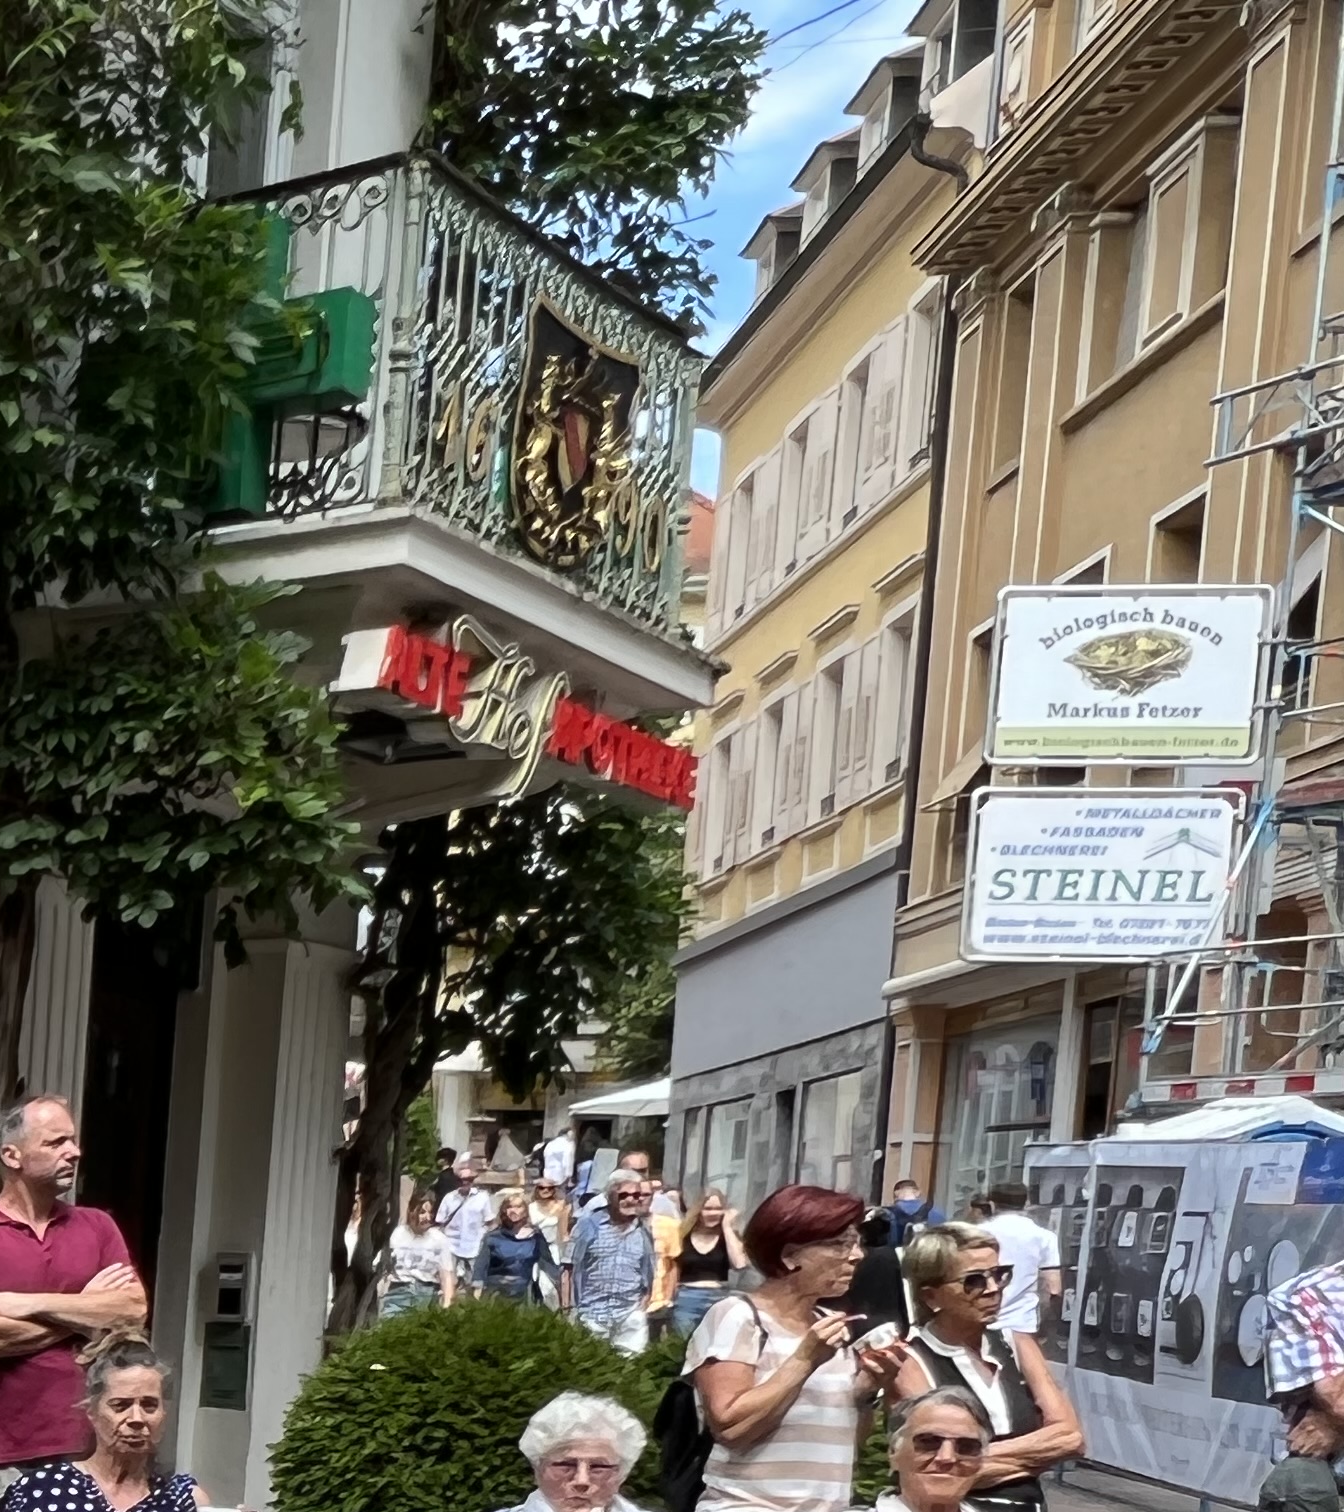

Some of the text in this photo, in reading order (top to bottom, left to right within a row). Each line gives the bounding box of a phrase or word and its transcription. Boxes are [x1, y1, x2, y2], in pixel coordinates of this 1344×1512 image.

[1039, 607, 1224, 650] biologisch bauen
[379, 624, 472, 717] ALTE
[1046, 702, 1204, 719] Markus Fetzer
[988, 868, 1215, 902] STEINEL
